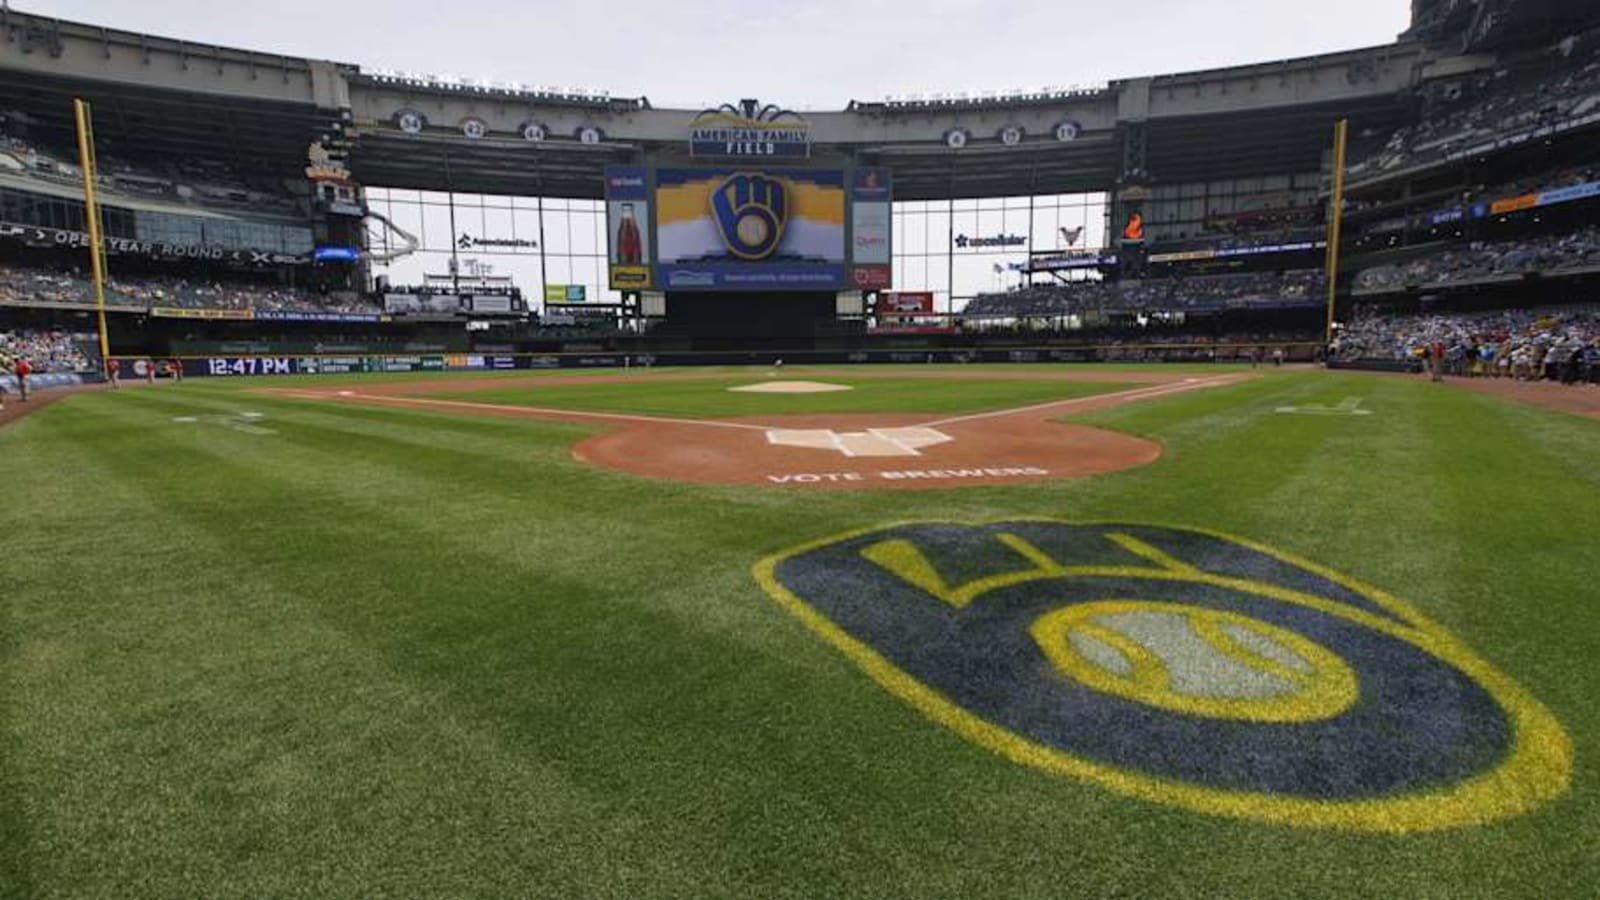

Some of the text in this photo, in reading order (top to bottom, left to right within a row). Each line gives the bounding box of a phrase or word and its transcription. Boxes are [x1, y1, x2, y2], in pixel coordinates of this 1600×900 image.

[692, 129, 806, 141] AMERICAN FAMILY
[727, 142, 774, 154] FIELD
[55, 230, 97, 247] OPE
[110, 236, 153, 254] YEAR
[162, 244, 223, 260] ROUND
[208, 357, 291, 375] 12:47 PM
[767, 466, 1048, 483] VOTE BREWERS
